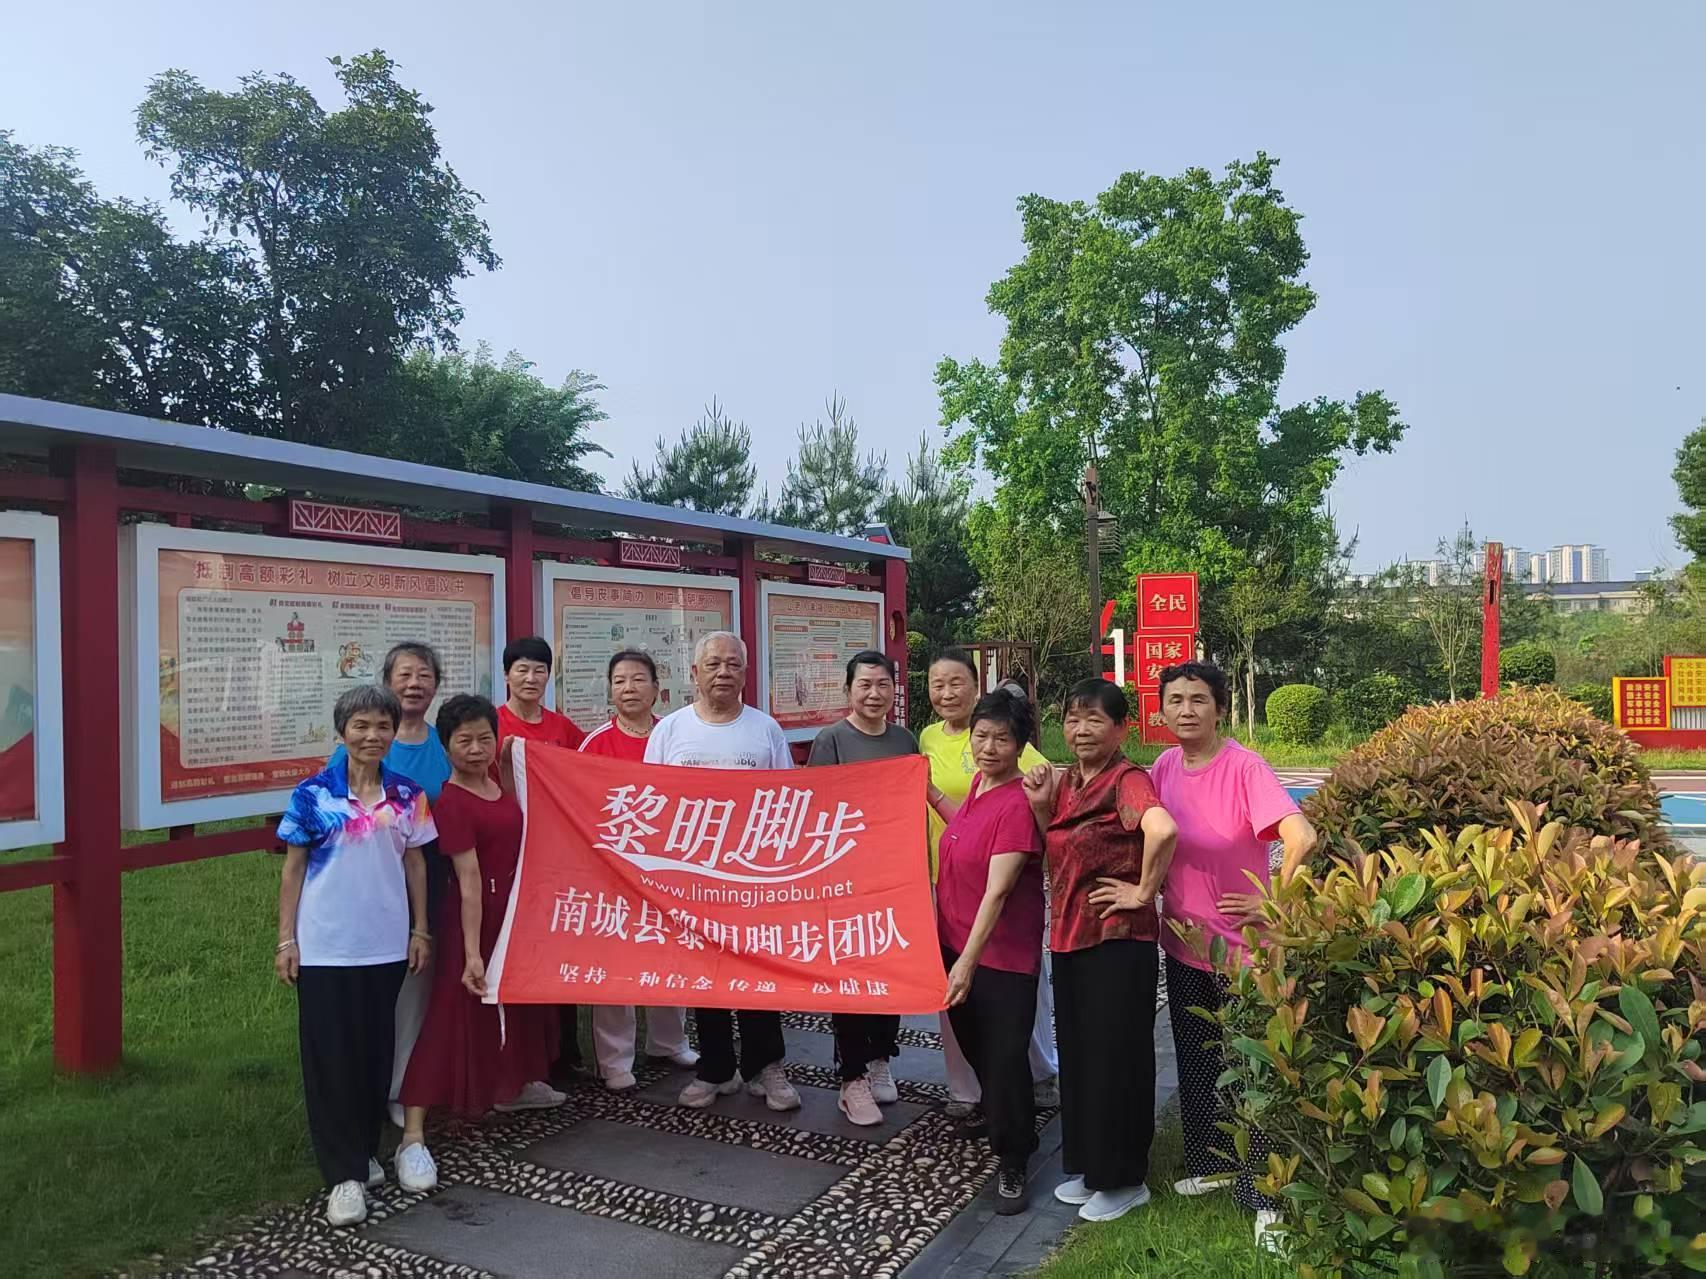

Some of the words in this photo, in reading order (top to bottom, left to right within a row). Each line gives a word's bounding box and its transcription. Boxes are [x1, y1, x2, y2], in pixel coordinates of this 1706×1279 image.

[196, 562, 313, 585] 抵制高额彩礼
[328, 568, 465, 593] 树立文明新风倡议书
[1150, 594, 1187, 612] 全民
[1146, 641, 1183, 660] 国家
[595, 784, 866, 870] 黎明脚步
[639, 873, 853, 908] www.limingjiaobu.net
[550, 887, 910, 965] 南城县黎明脚步团队
[559, 964, 713, 991] 坚持一种信念
